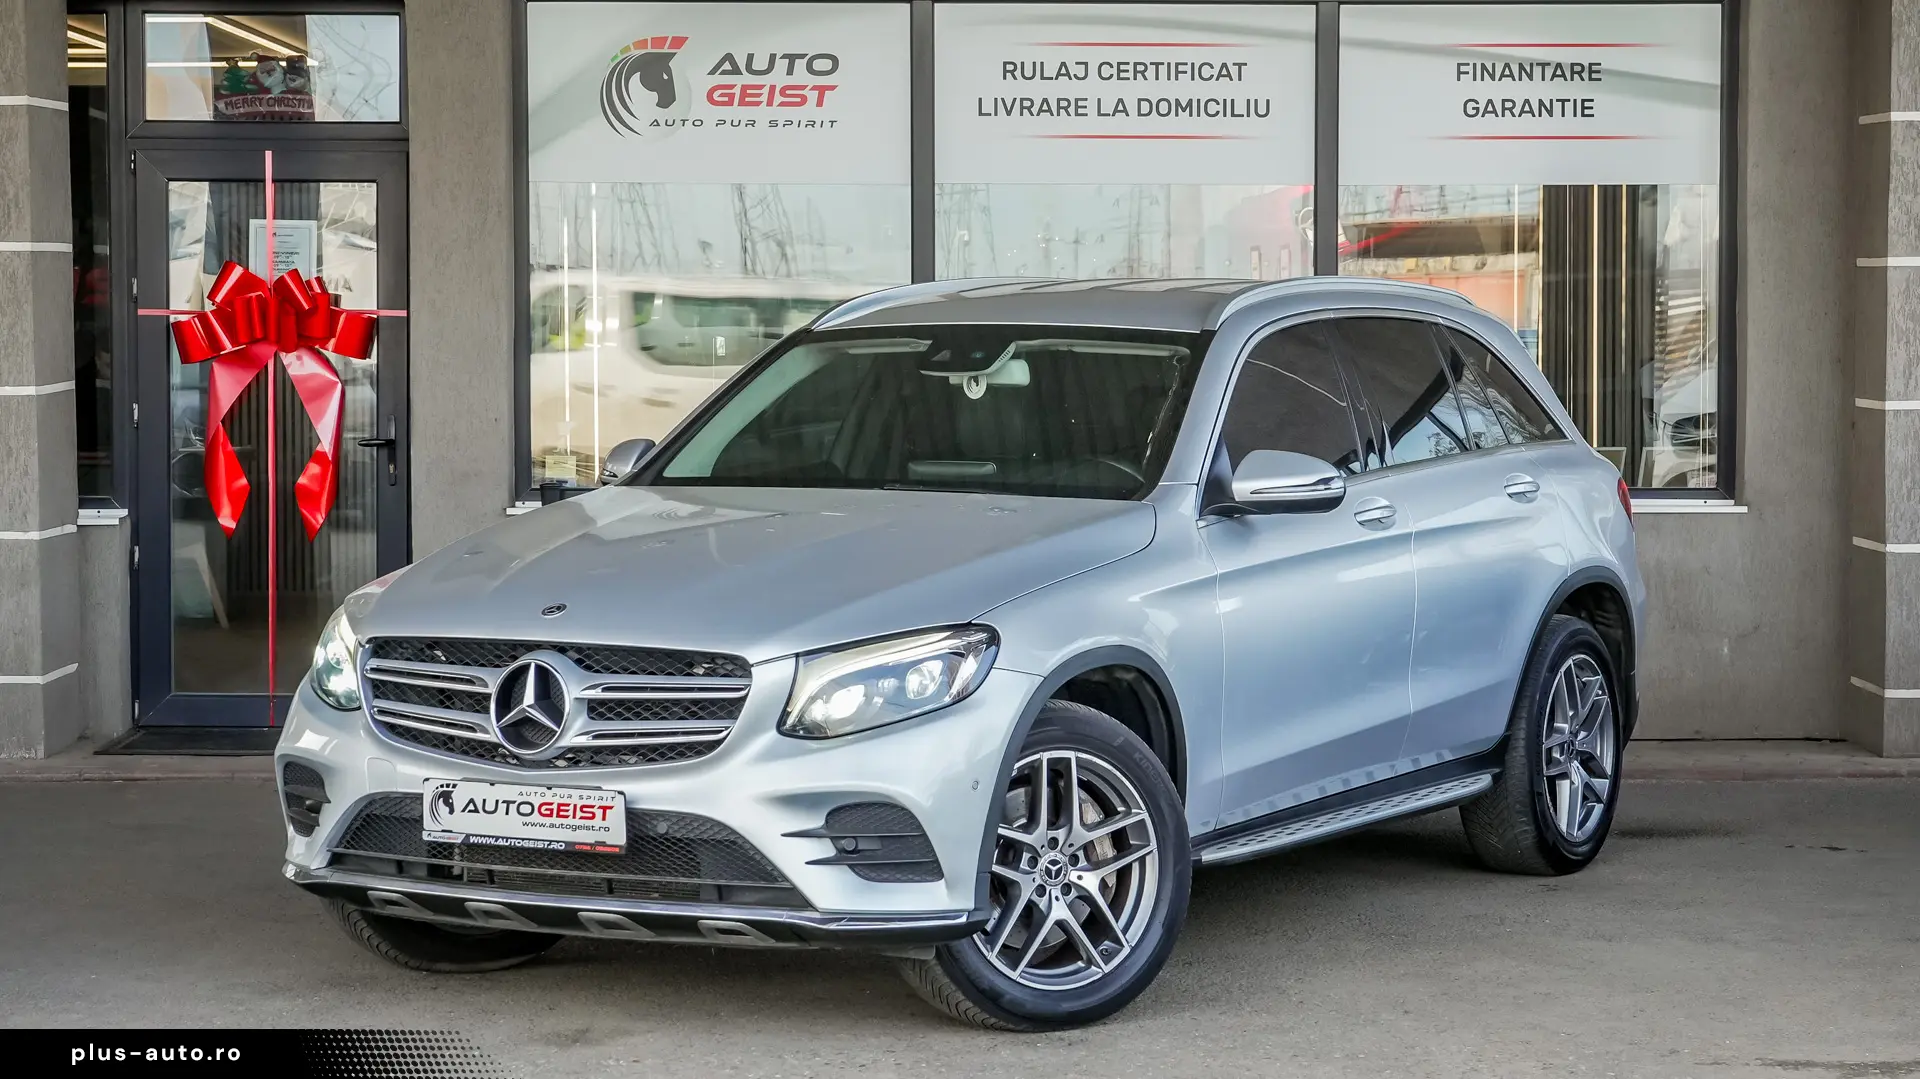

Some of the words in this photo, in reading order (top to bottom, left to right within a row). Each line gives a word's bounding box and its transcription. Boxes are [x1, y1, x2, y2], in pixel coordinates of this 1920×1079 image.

[706, 52, 840, 77] AUTO
[1002, 61, 1089, 81] RULAJ
[1097, 61, 1248, 82] CERTIFICAT
[1456, 62, 1603, 82] FINANTARE
[223, 96, 265, 111] MERRY
[705, 83, 839, 108] GEIST
[977, 97, 1089, 117] LIVRARE
[1096, 97, 1130, 118] LA
[1136, 98, 1271, 119] DOMICILIU
[1462, 98, 1595, 119] GARANTIE
[648, 118, 704, 128] AUTO
[715, 118, 757, 129] PUR
[767, 119, 838, 129] SPIRIT
[517, 790, 547, 798] AUTO
[551, 792, 573, 800] PUR
[578, 794, 617, 802] SPIRIT
[460, 797, 615, 822] AUTOGEIST
[521, 820, 611, 833] www.autogeist.ro
[469, 835, 566, 850] WWW.AUTOGEIST.RO
